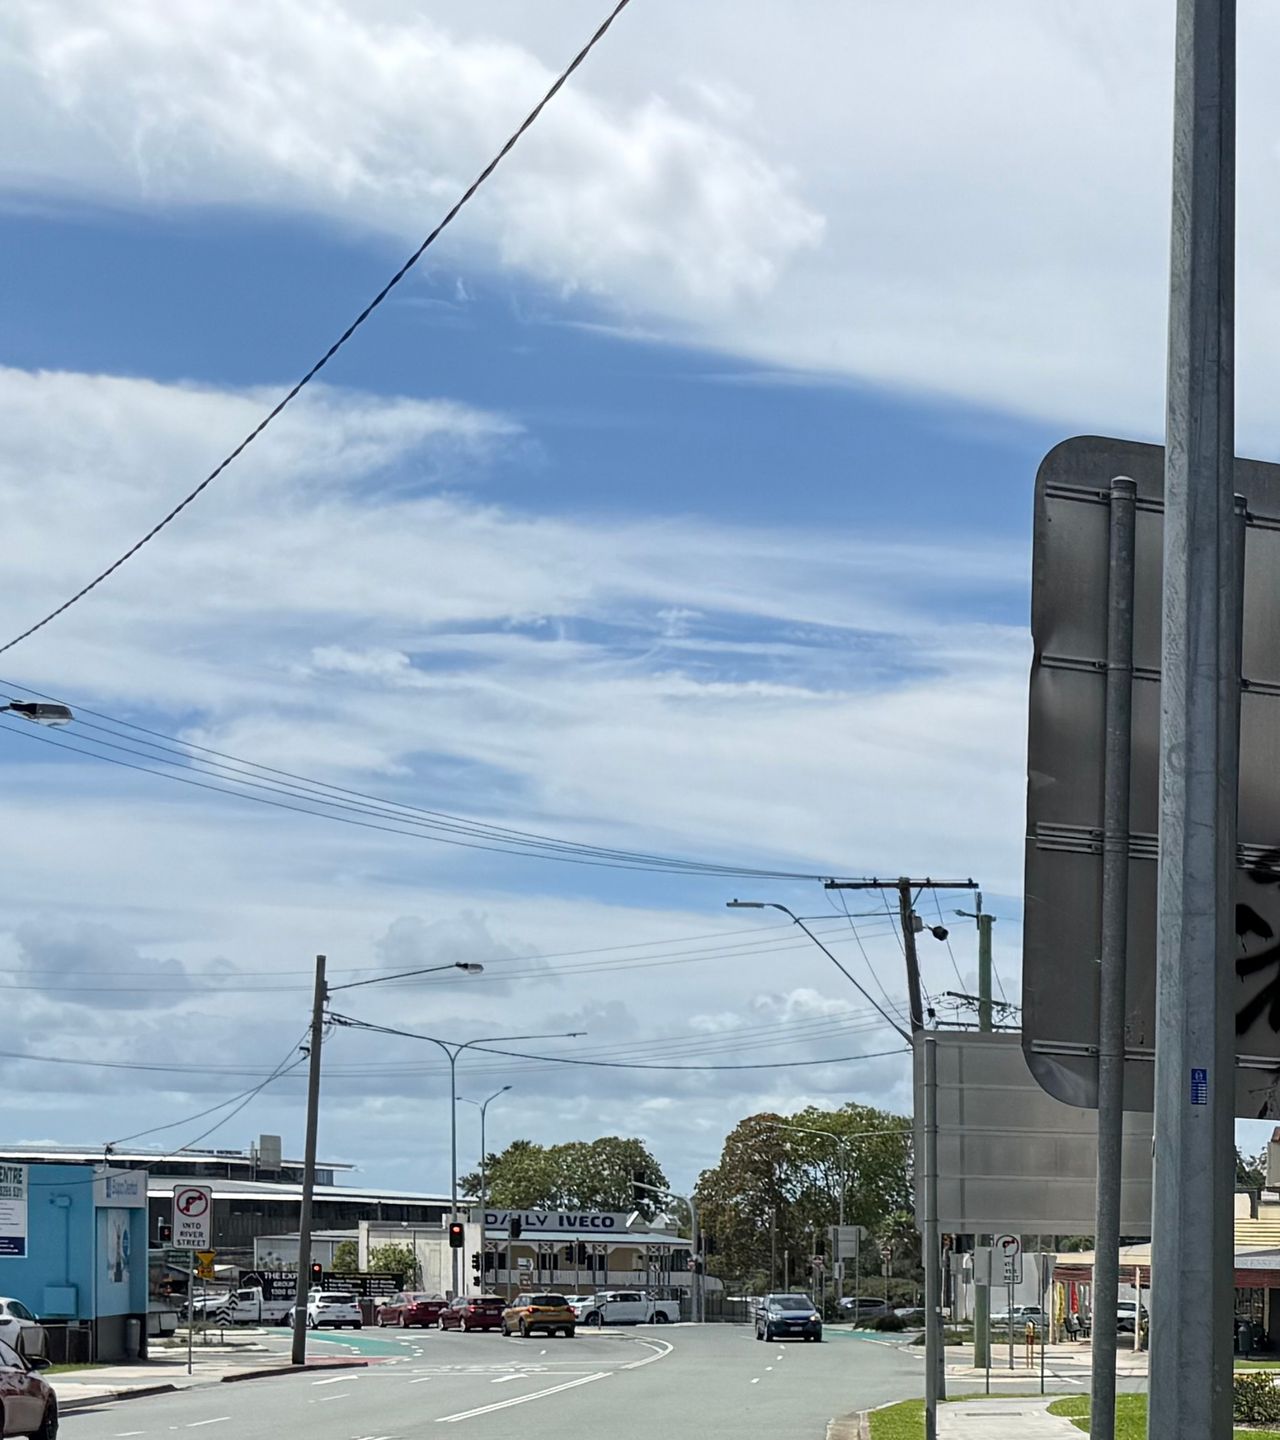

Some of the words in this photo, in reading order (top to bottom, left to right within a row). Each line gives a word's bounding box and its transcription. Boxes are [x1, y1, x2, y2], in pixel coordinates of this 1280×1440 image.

[558, 1215, 615, 1228] IVECO
[176, 1239, 206, 1247] STREET
[264, 1271, 281, 1280] THE
